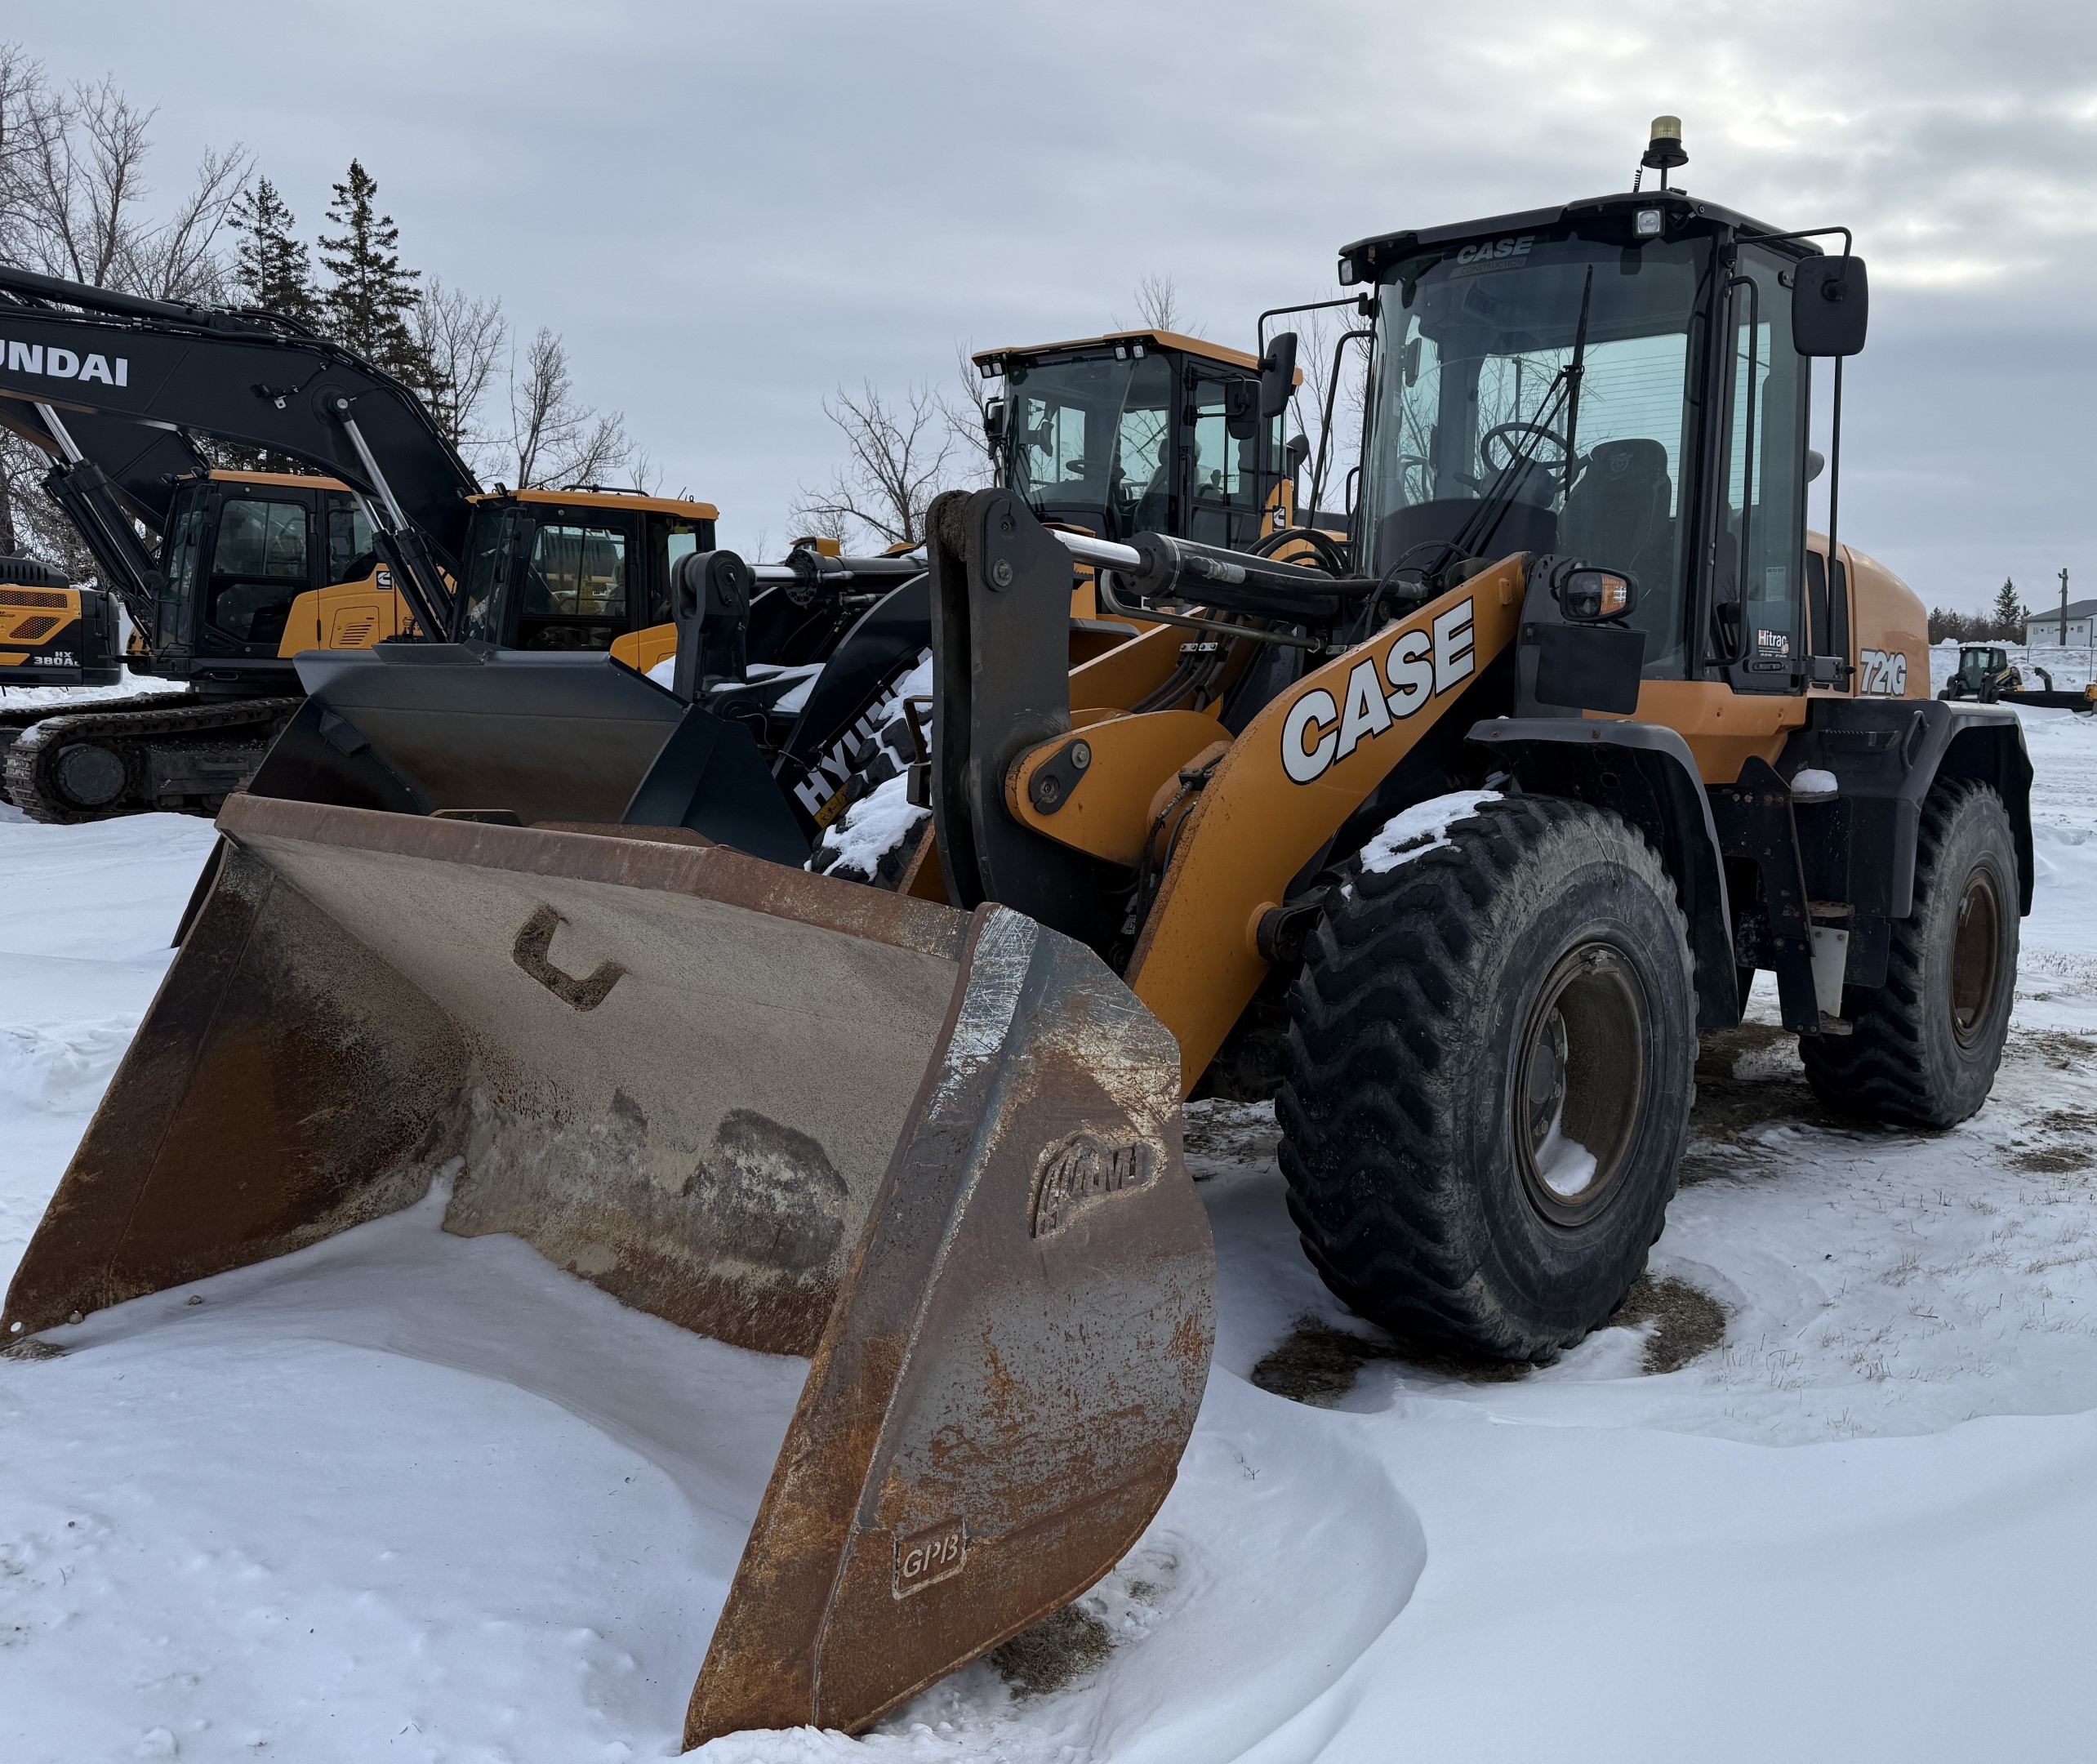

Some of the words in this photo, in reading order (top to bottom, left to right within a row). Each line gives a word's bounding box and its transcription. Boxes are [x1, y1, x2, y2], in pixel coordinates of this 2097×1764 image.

[1457, 235, 1535, 265] CASE
[0, 339, 128, 387] NDAI
[1280, 595, 1476, 786] CASE
[1860, 648, 1908, 697] 721G
[903, 1534, 959, 1578] GPB
